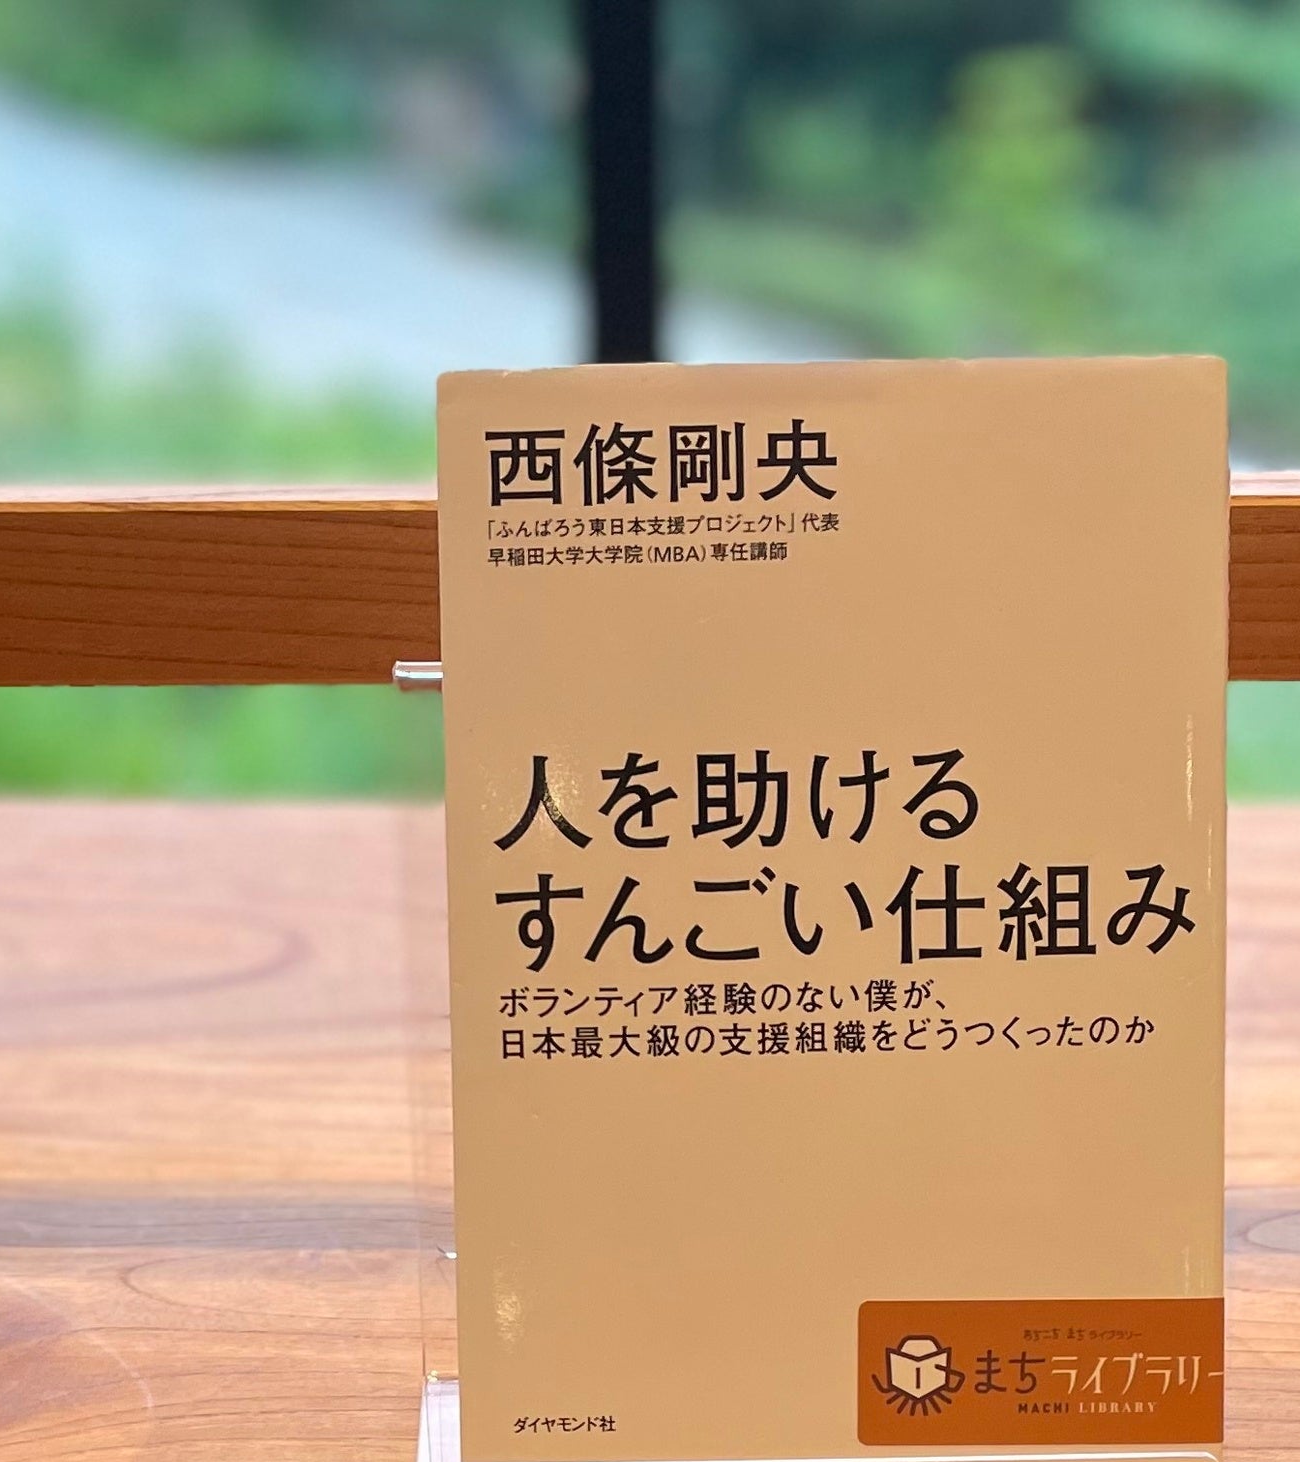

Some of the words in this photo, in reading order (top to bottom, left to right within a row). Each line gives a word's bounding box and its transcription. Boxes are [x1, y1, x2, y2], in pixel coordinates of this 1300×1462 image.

[484, 419, 840, 506] 西條剛央
[487, 513, 840, 539] 「ふんばろう東日本支援プロジェクト」代表
[486, 542, 789, 566] 早稲田大学大学院(MBA)専任講師
[494, 748, 981, 852] 人を助ける
[495, 863, 1196, 973] すんごい仕組み
[498, 979, 948, 1018] ボランティア経験のない僕が、
[499, 1016, 1156, 1060] 日本最大級の支援組織をどうつくったのか
[974, 1350, 1225, 1396] まちライブラリー
[513, 1416, 617, 1434] ダイヤモンド社
[1018, 1403, 1069, 1414] MACHI
[1078, 1402, 1157, 1414] LIBRARY
